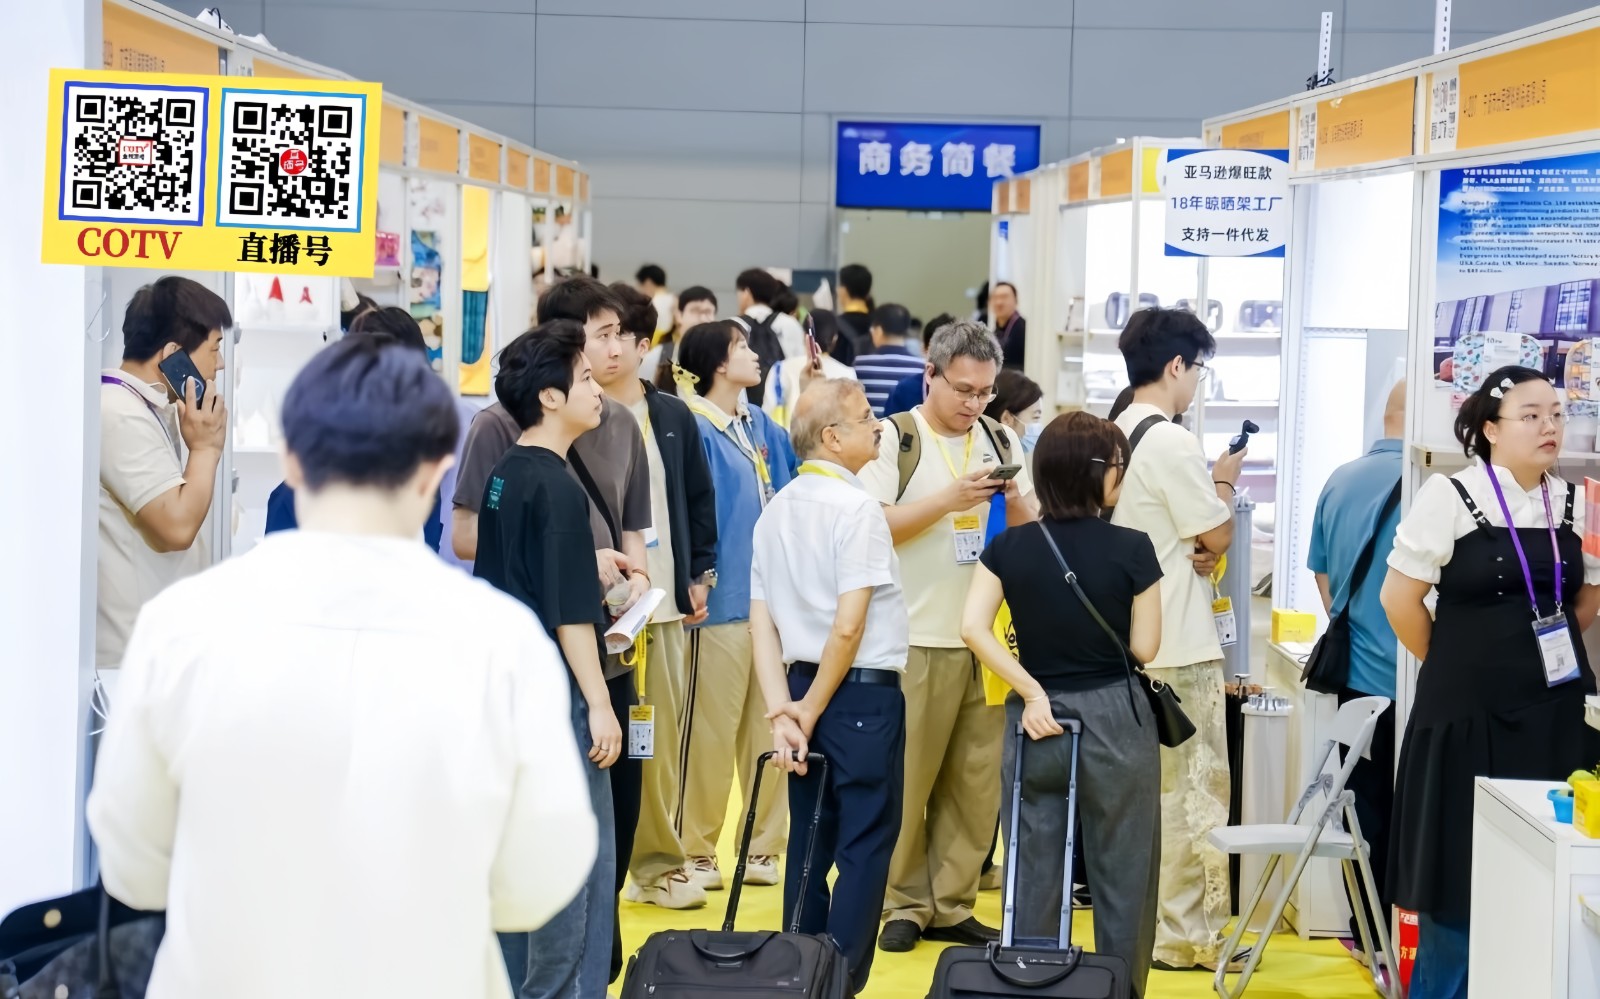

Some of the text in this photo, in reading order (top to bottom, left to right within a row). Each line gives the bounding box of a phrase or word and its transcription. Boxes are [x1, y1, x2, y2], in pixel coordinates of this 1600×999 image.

[1184, 165, 1272, 180] 亚马逊爆旺款
[1171, 196, 1283, 211] 18年晾晒架工厂
[1182, 227, 1269, 242] 支持一件代发
